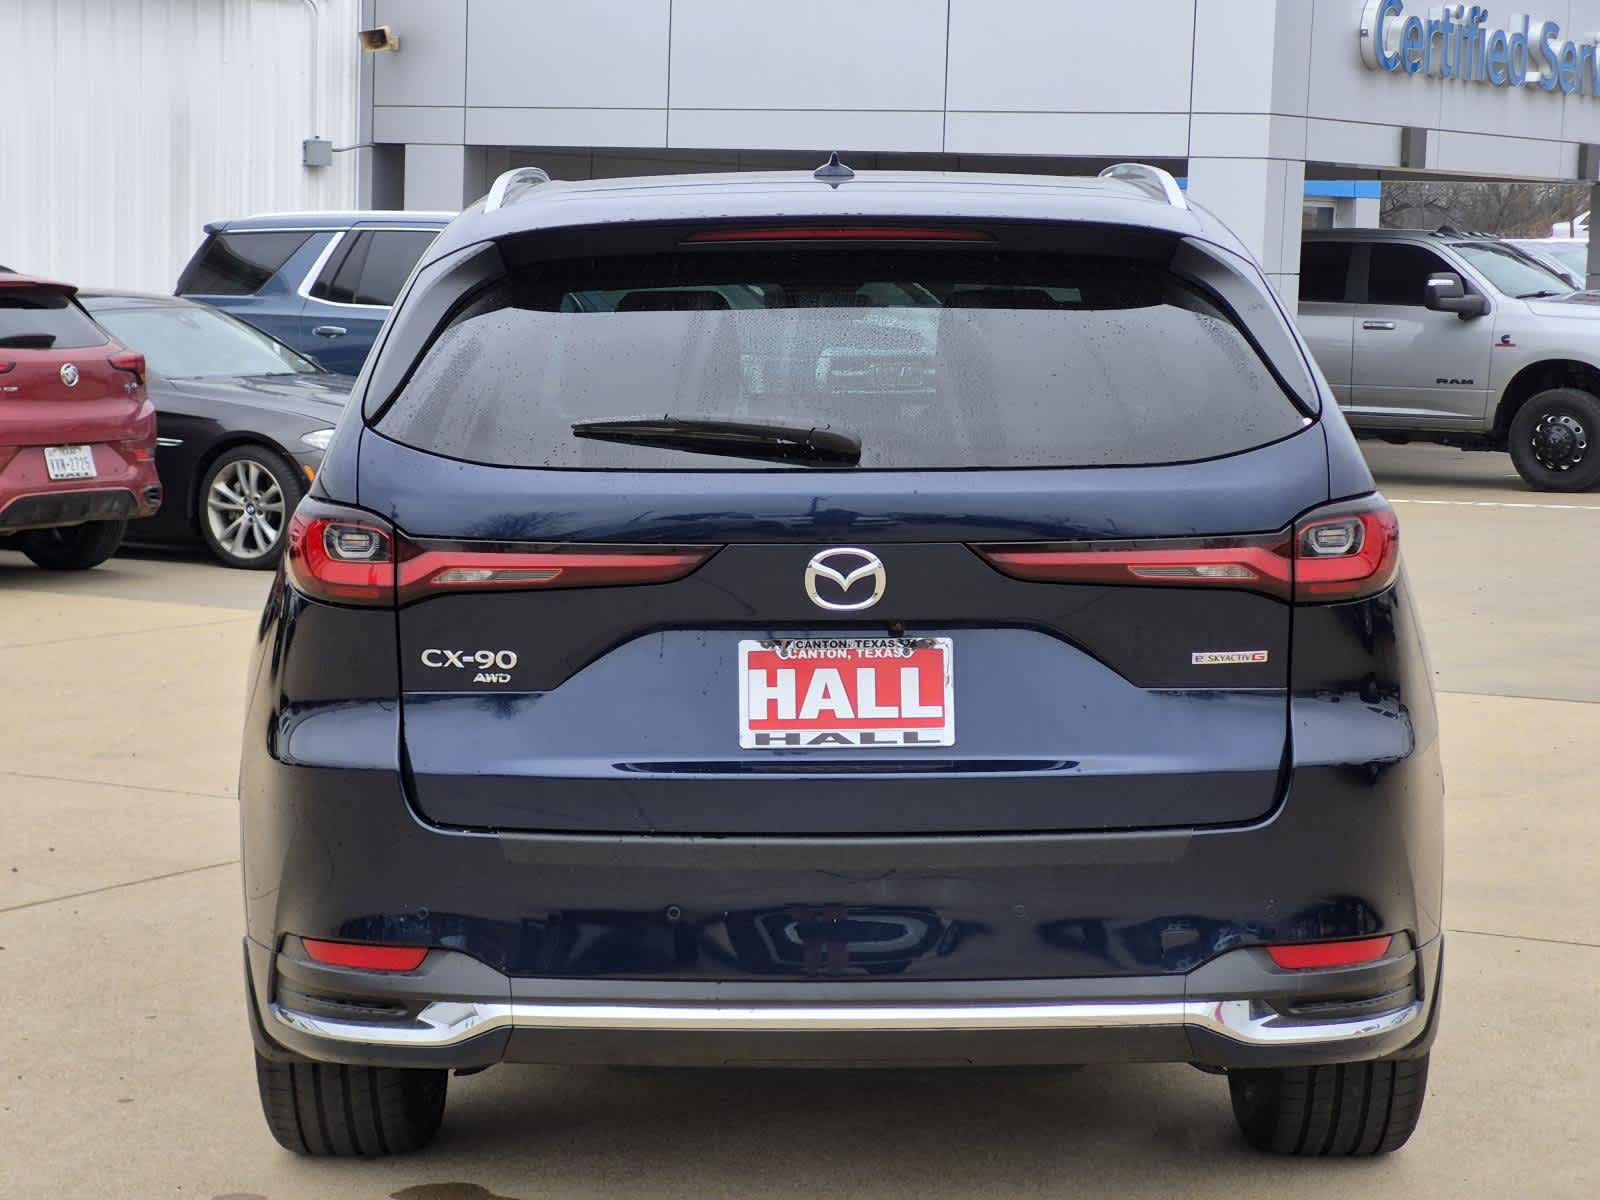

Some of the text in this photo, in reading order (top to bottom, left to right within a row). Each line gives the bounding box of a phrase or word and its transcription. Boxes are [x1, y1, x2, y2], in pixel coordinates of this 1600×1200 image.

[1371, 0, 1529, 87] Certified
[855, 639, 895, 648] TEXAS
[420, 648, 518, 670] CX-90
[790, 649, 902, 660] CANTON, TEXAS
[473, 672, 512, 684] AWD
[748, 667, 944, 720] HALL
[755, 731, 941, 746] HALL
